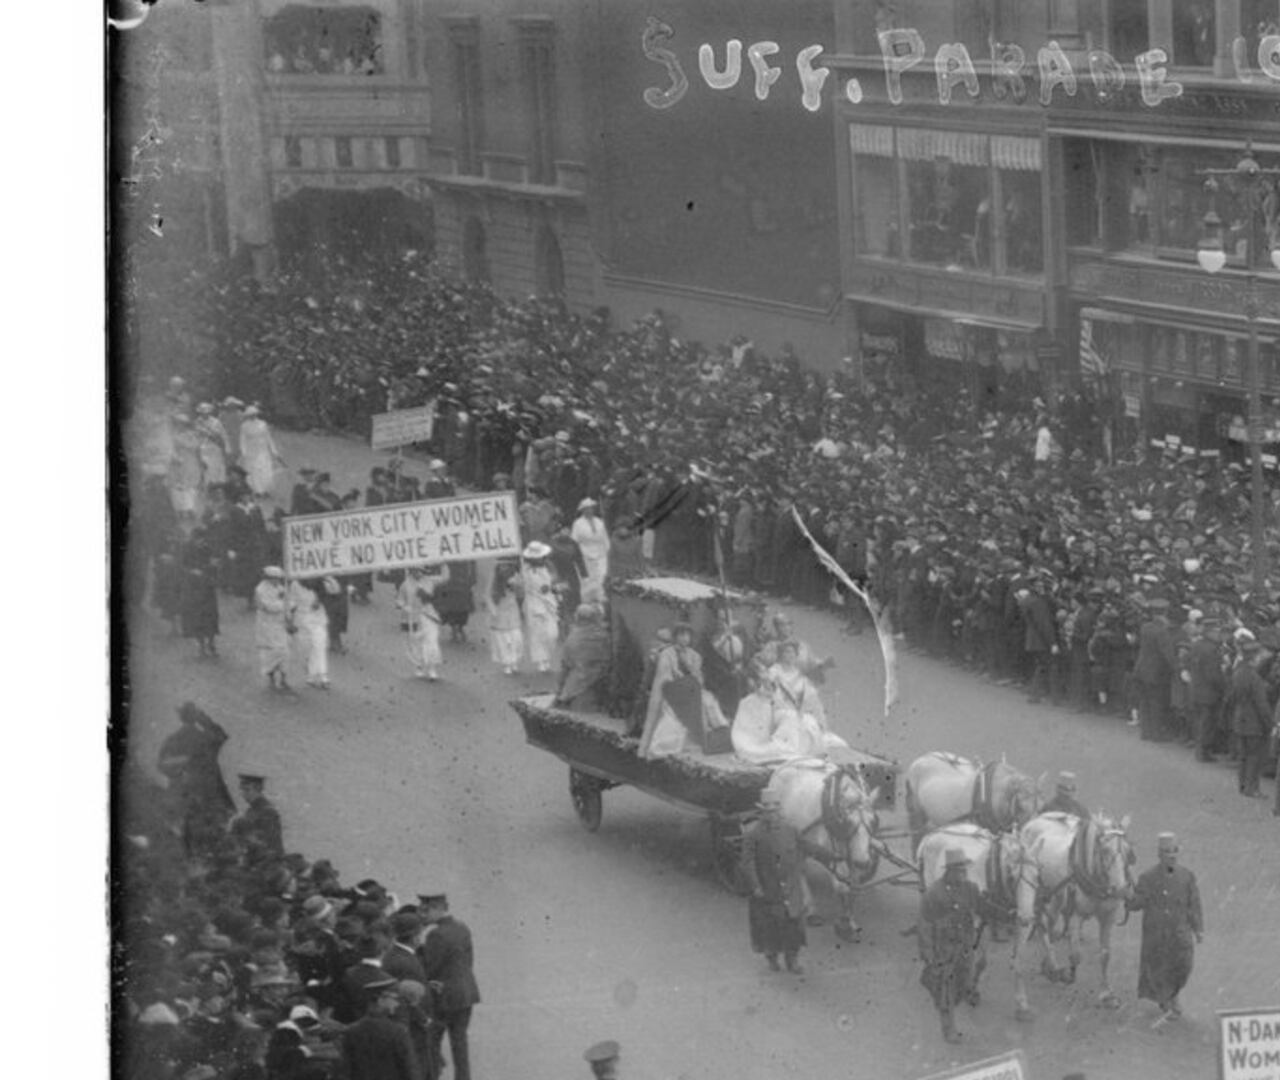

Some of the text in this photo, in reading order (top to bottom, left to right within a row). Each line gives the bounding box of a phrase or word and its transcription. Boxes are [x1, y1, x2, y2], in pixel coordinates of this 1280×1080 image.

[291, 499, 507, 545] NEW YORK CITY WOMEN
[291, 527, 511, 571] HAVE NO VOTE AT ALL
